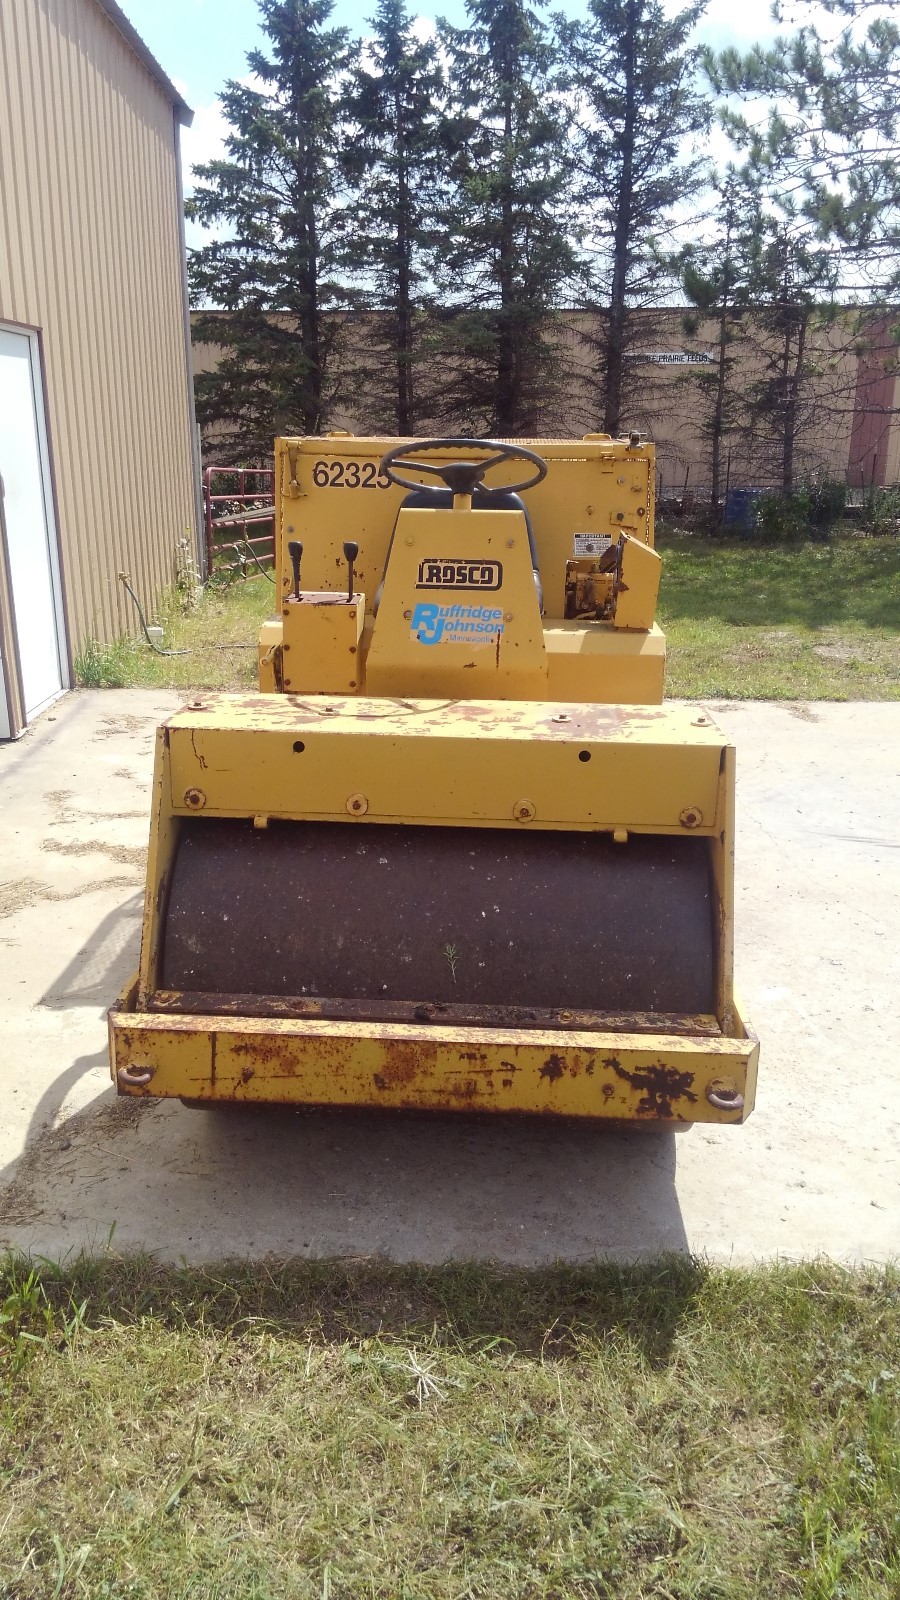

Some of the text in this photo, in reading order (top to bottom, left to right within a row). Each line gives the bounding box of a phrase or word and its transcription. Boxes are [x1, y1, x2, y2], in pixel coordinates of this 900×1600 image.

[658, 354, 685, 362] PRAIRIE
[312, 460, 393, 489] 62325
[425, 564, 494, 584] ROSCO
[411, 603, 503, 631] Ruffridge
[418, 618, 505, 645] Johnson
